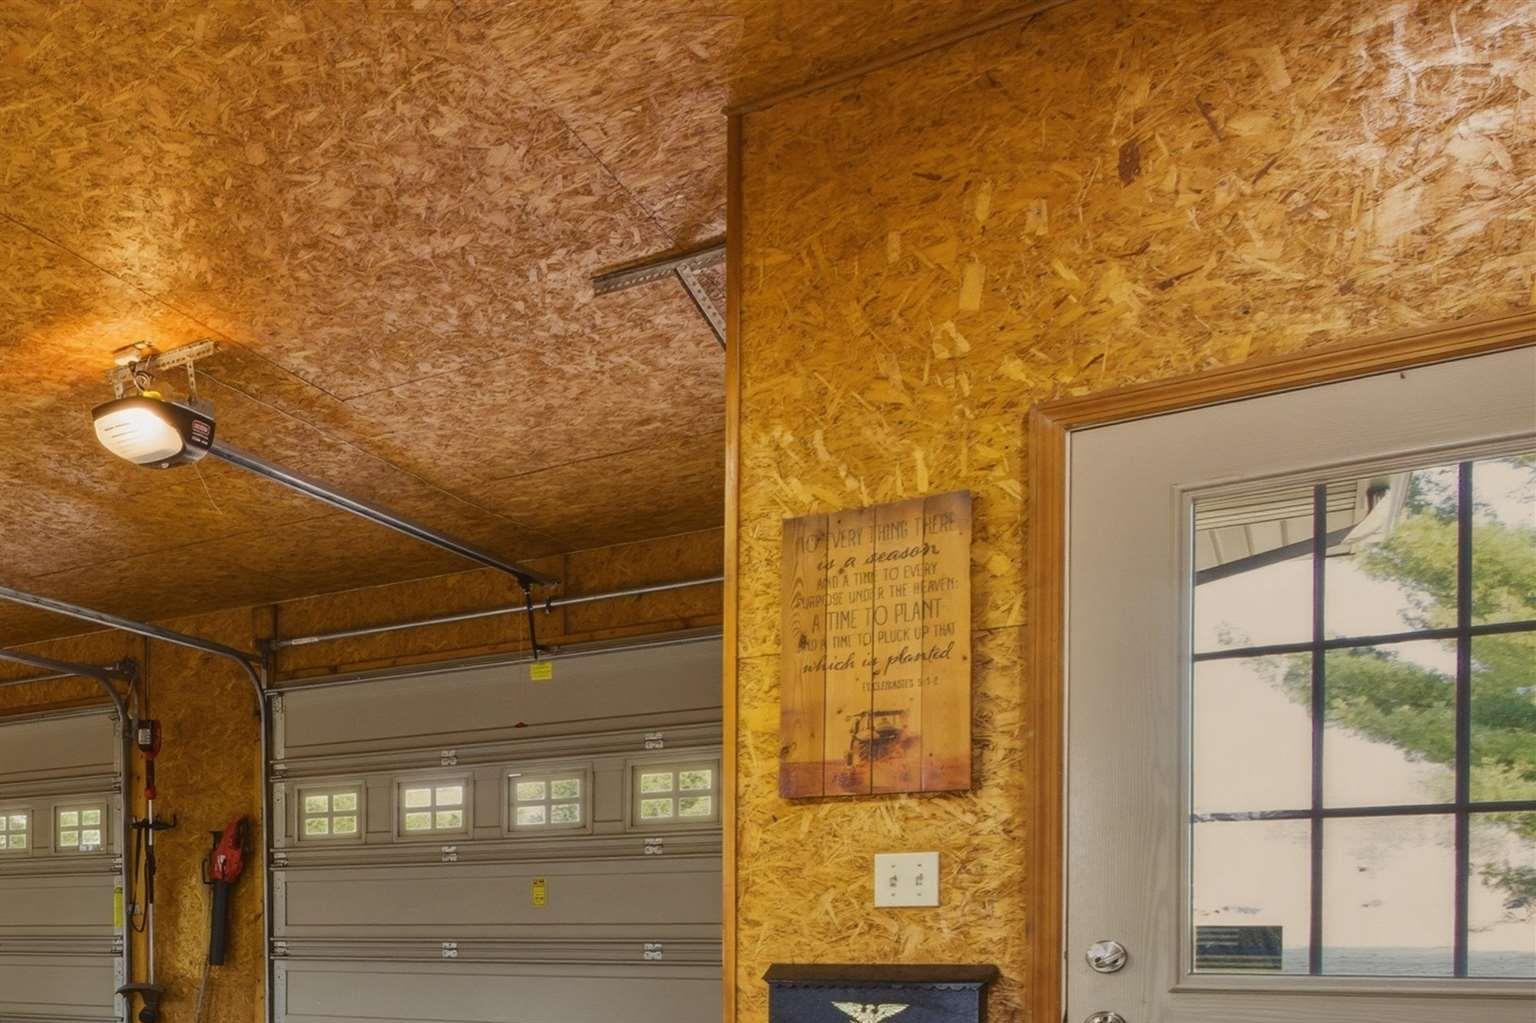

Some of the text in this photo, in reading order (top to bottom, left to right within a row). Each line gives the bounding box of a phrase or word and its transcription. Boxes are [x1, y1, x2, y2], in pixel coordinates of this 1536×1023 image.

[819, 527, 863, 549] VERY
[843, 556, 857, 570] a
[864, 541, 940, 564] season
[882, 566, 900, 582] TO
[889, 582, 913, 598] THE
[811, 597, 943, 634] A TIME TO PLANT
[877, 628, 910, 645] PLUCK
[802, 651, 856, 674] which
[882, 639, 956, 676] planted
